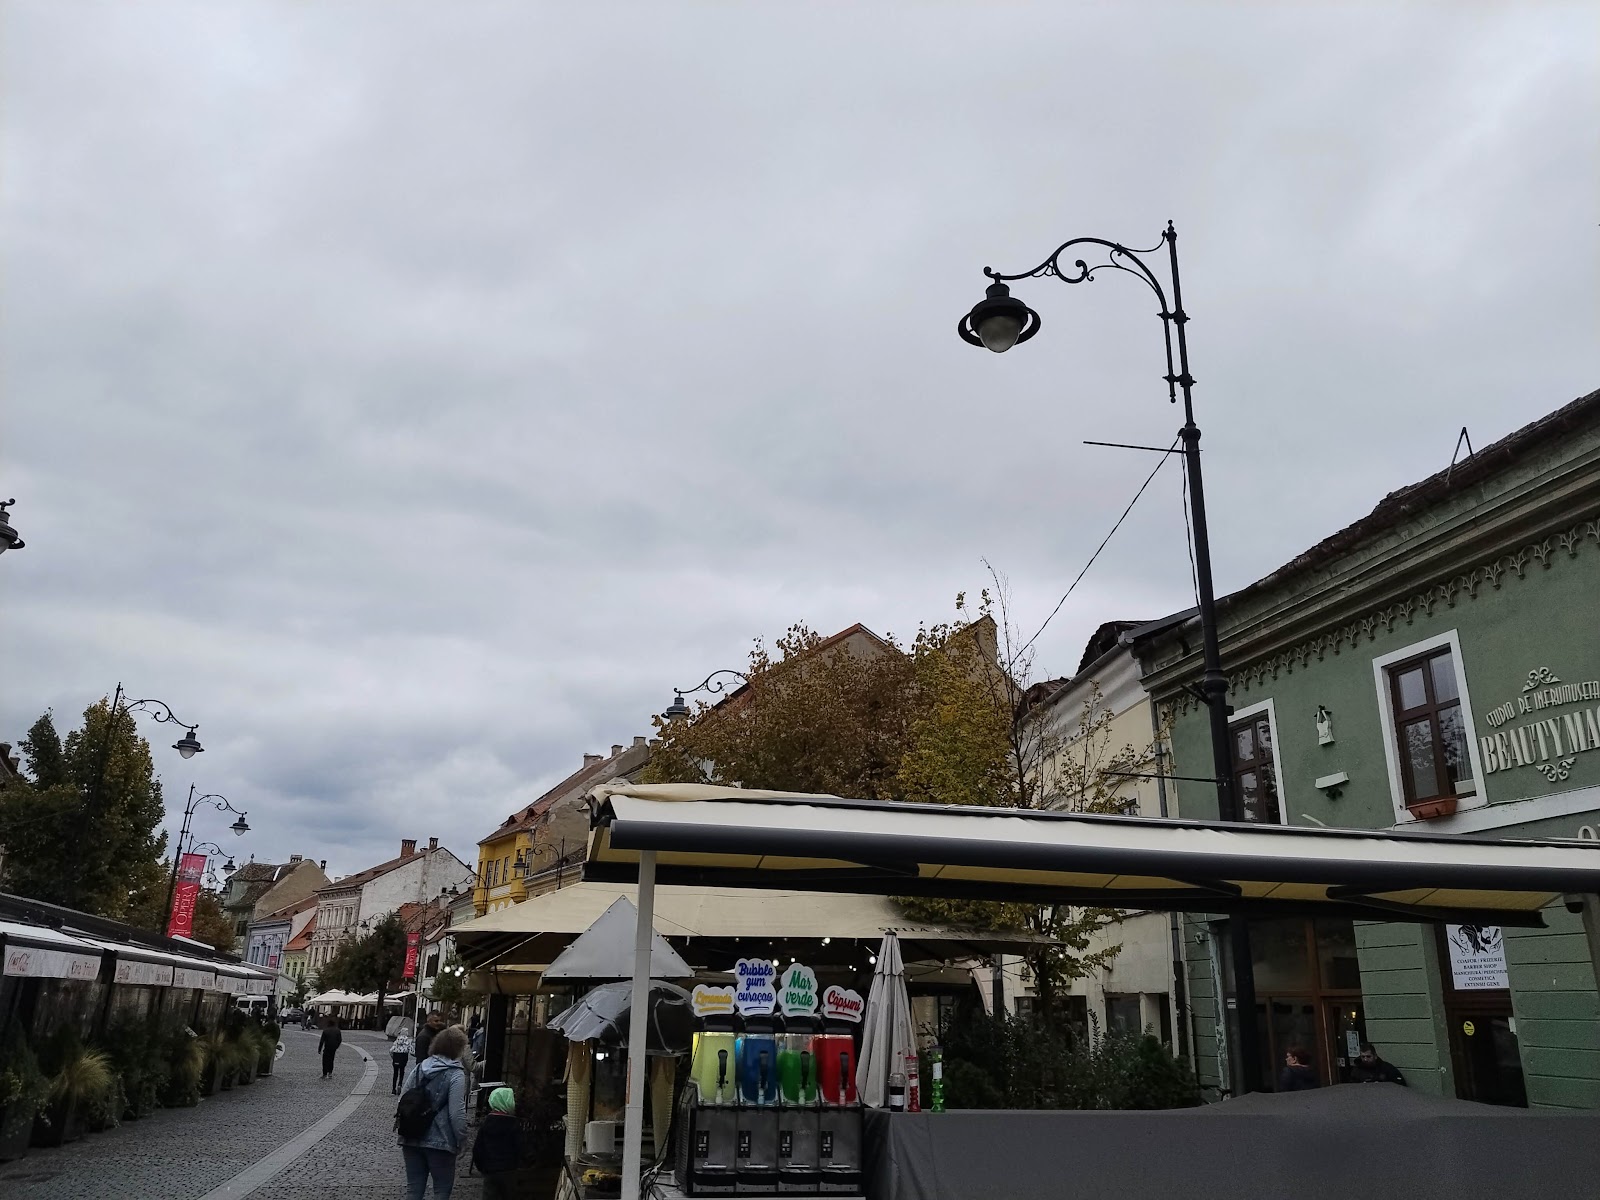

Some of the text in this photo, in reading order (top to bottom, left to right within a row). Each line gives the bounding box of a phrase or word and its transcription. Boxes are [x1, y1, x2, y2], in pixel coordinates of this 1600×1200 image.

[1486, 701, 1516, 728] STUDIO
[1518, 694, 1533, 714] DE
[1479, 705, 1600, 774] BEAUTYMA
[176, 885, 194, 925] OPERA
[738, 963, 774, 976] Bubble
[746, 977, 766, 990] gum
[786, 991, 814, 1006] verde
